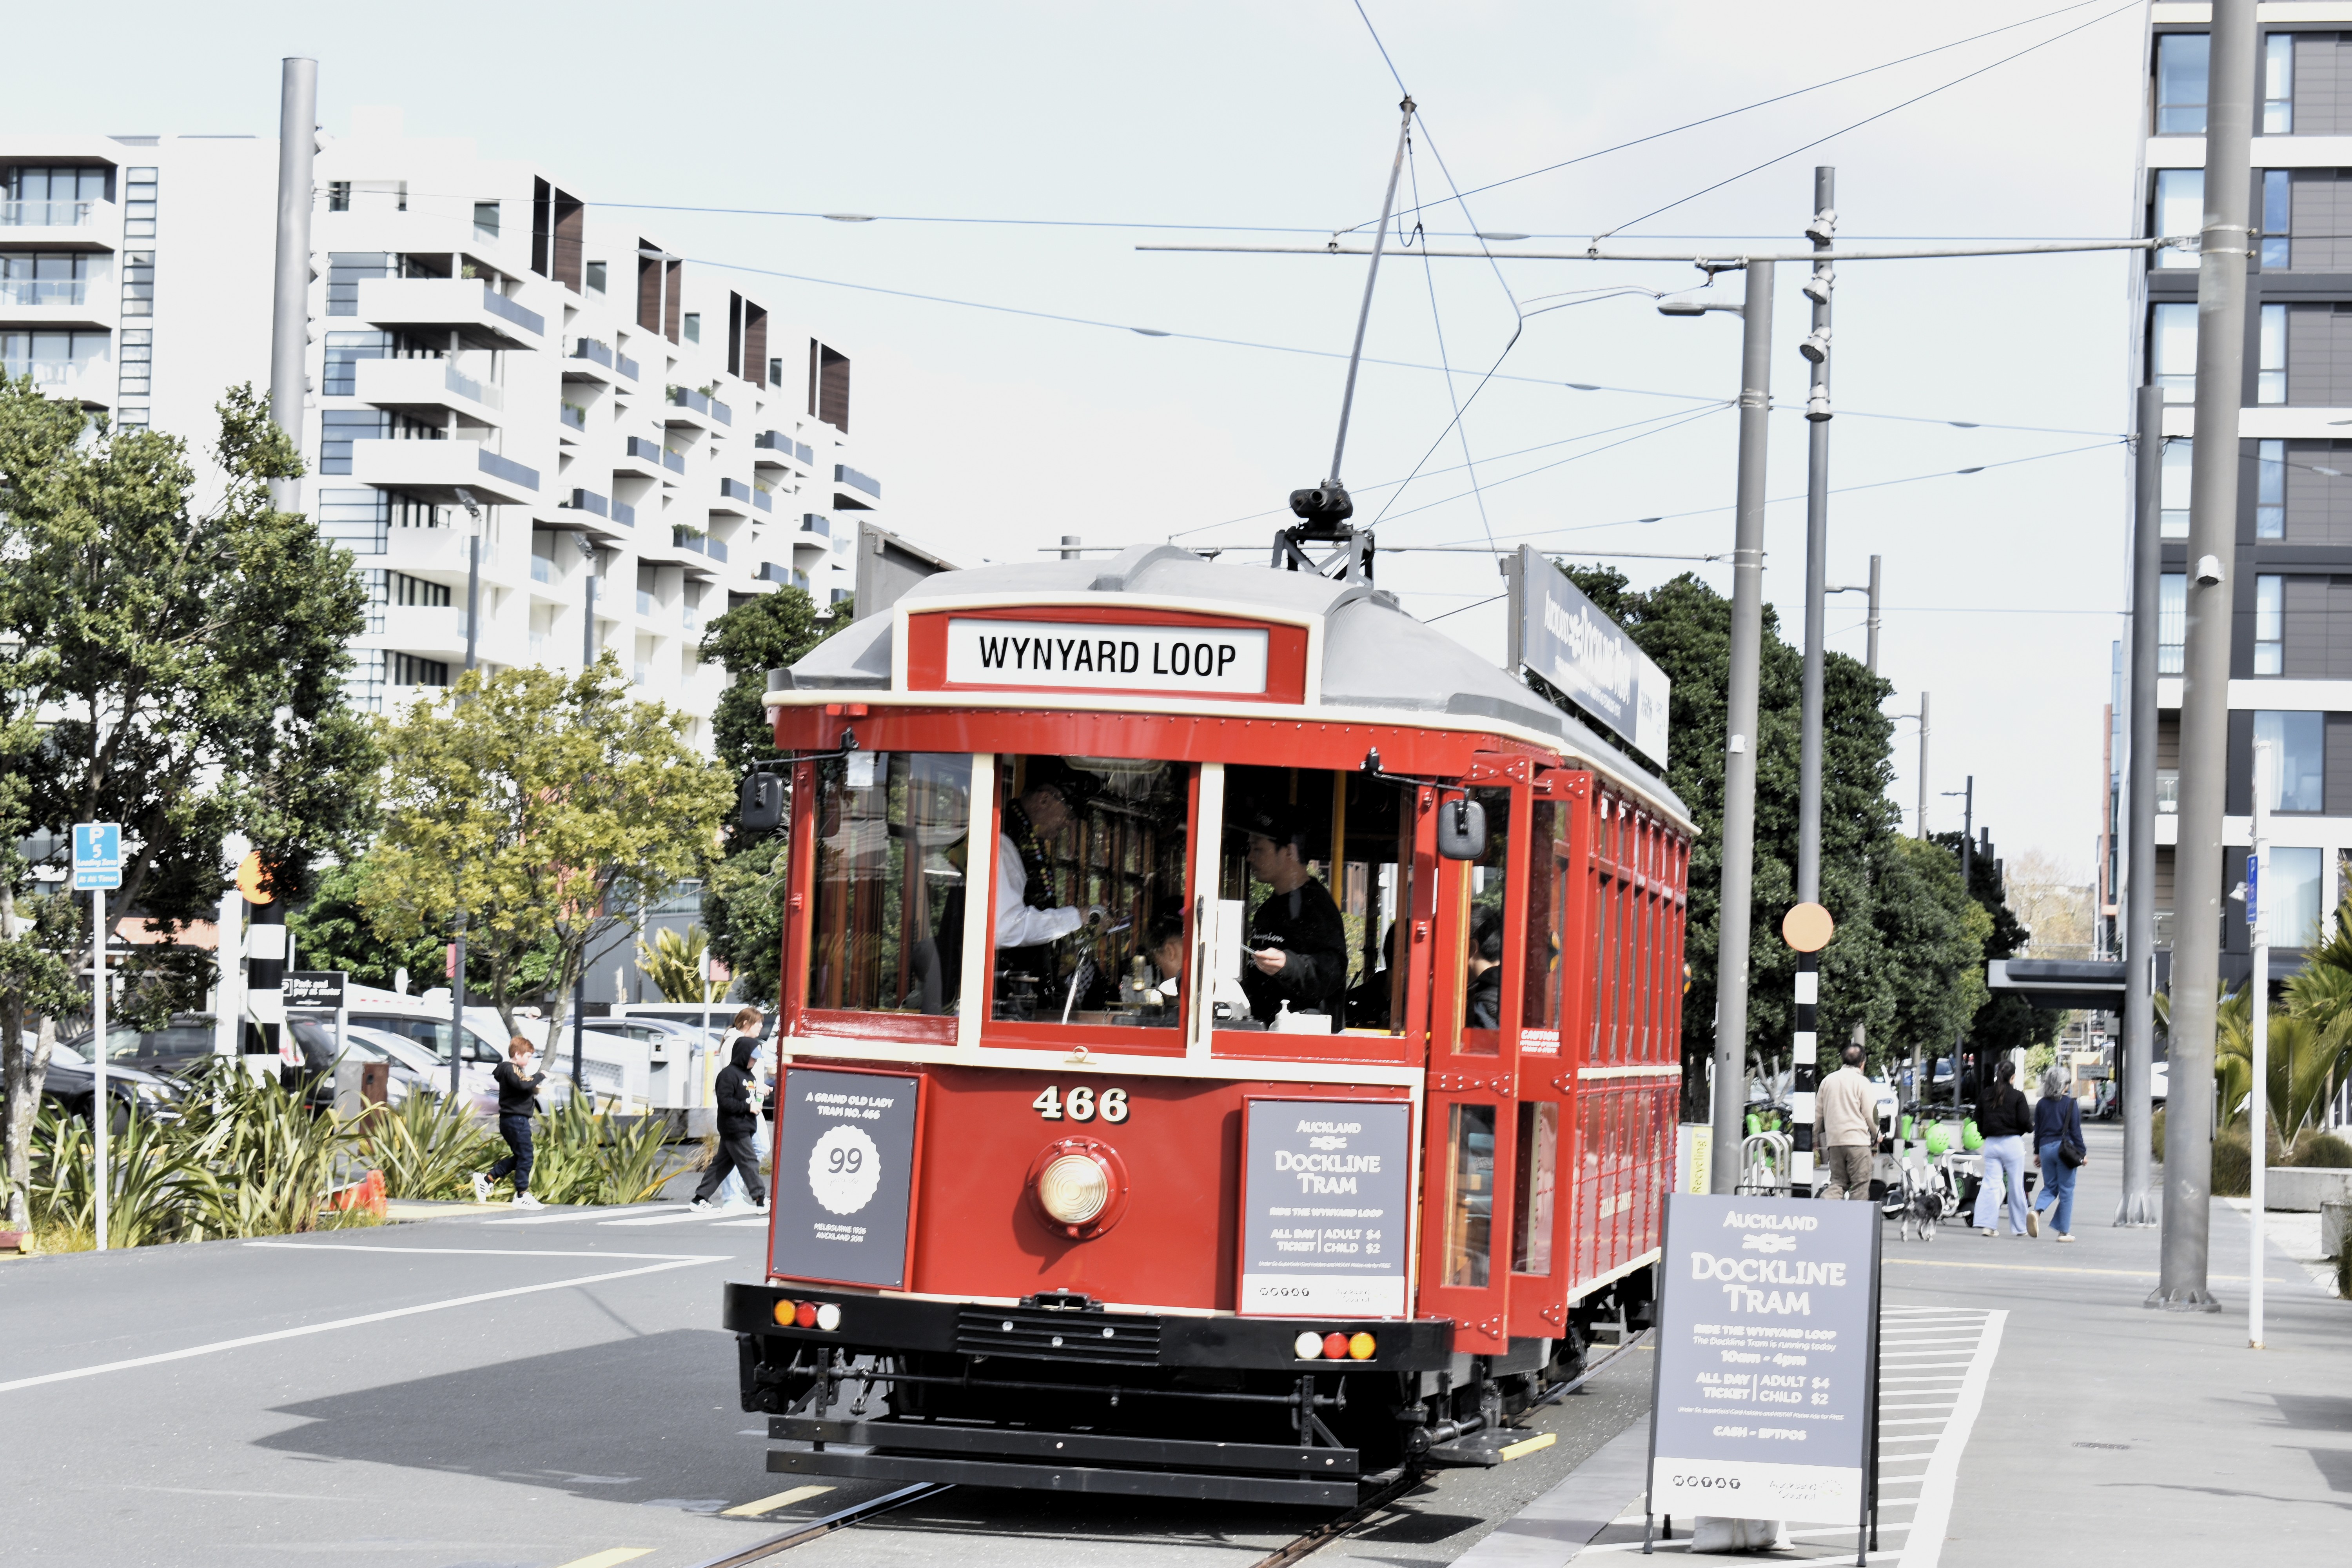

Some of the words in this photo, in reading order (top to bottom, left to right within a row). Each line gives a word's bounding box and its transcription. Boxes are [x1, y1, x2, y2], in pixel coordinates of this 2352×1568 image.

[980, 636, 1139, 673] WYNYARD
[1153, 642, 1236, 677] LOOP
[90, 827, 104, 844] P
[93, 844, 102, 858] 5
[294, 979, 312, 988] Park
[1521, 1029, 1559, 1041] CAUTION
[805, 1092, 813, 1101] A
[814, 1093, 848, 1104] GRAND
[848, 1096, 868, 1105] OLD
[868, 1097, 894, 1108] LADY
[1033, 1085, 1129, 1123] 466
[817, 1105, 844, 1116] TRAM
[862, 1109, 880, 1119] 466
[1296, 1120, 1361, 1133] AUCKLAND
[828, 1148, 862, 1173] 99
[1275, 1150, 1381, 1173] DOCKLINE
[1691, 1140, 1707, 1193] Recycling
[1297, 1172, 1357, 1194] TRAM
[1269, 1207, 1292, 1216] RIDE
[1292, 1208, 1310, 1216] THE
[1311, 1208, 1357, 1217] WYNYARD
[1357, 1209, 1383, 1217] LOOP
[814, 1223, 853, 1233] MELBOURNE
[1722, 1210, 1818, 1231] AUCKLAND
[815, 1231, 850, 1241] AUCKLAND
[1270, 1229, 1292, 1239] ALL
[1293, 1229, 1316, 1239] DAY
[1323, 1229, 1363, 1240] ADULT
[1366, 1229, 1381, 1240] $4
[1276, 1241, 1316, 1251] TICKET
[1323, 1243, 1359, 1253] CHILD
[1365, 1243, 1381, 1254] $2
[1691, 1252, 1846, 1286] DOCKLINE
[1722, 1284, 1811, 1315] TRAM
[1694, 1324, 1720, 1334] RIDE
[1722, 1325, 1745, 1336] THE
[1746, 1326, 1804, 1338] WYNYARD
[1805, 1329, 1837, 1340] LOOP
[1693, 1336, 1708, 1345] The
[1710, 1337, 1746, 1347] Dockline
[1747, 1339, 1768, 1347] Tram
[1769, 1339, 1777, 1348] is
[1778, 1341, 1810, 1351] running
[1811, 1341, 1837, 1352] today
[1720, 1350, 1761, 1363] 10am
[1772, 1352, 1806, 1367] 4pm
[1695, 1372, 1722, 1384] ALL
[1723, 1373, 1751, 1385] DAY
[1760, 1374, 1807, 1388] ADULT
[1811, 1376, 1830, 1389] $4
[1703, 1387, 1750, 1399] TICKET
[1759, 1390, 1802, 1403] CHILD
[1811, 1392, 1828, 1405] $2
[1713, 1425, 1747, 1437] CASH
[1758, 1428, 1807, 1440] EFTPOS
